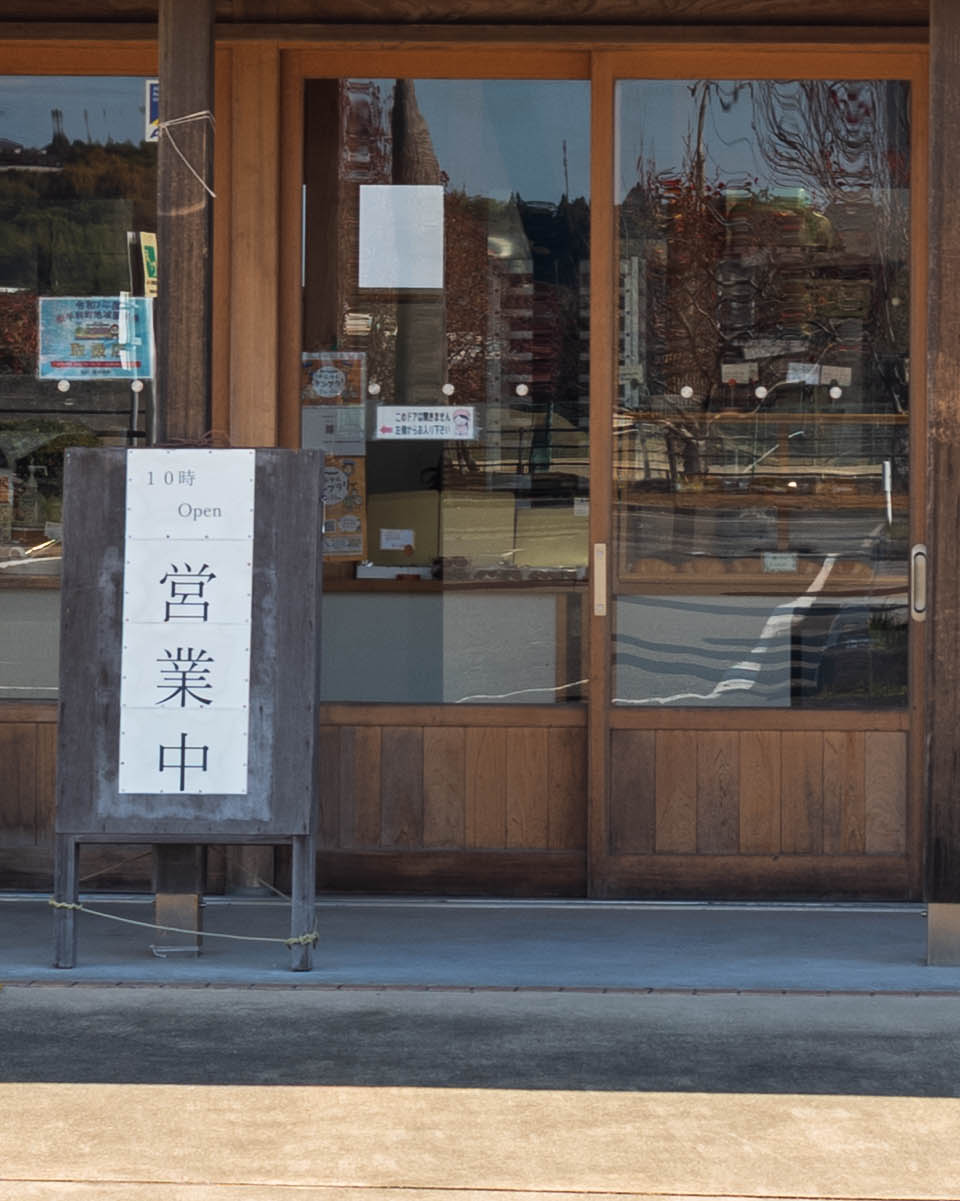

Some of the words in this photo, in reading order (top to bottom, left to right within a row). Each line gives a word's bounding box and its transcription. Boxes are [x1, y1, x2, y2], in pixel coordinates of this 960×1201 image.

[177, 502, 223, 521] Open
[155, 562, 217, 792] 営業中
